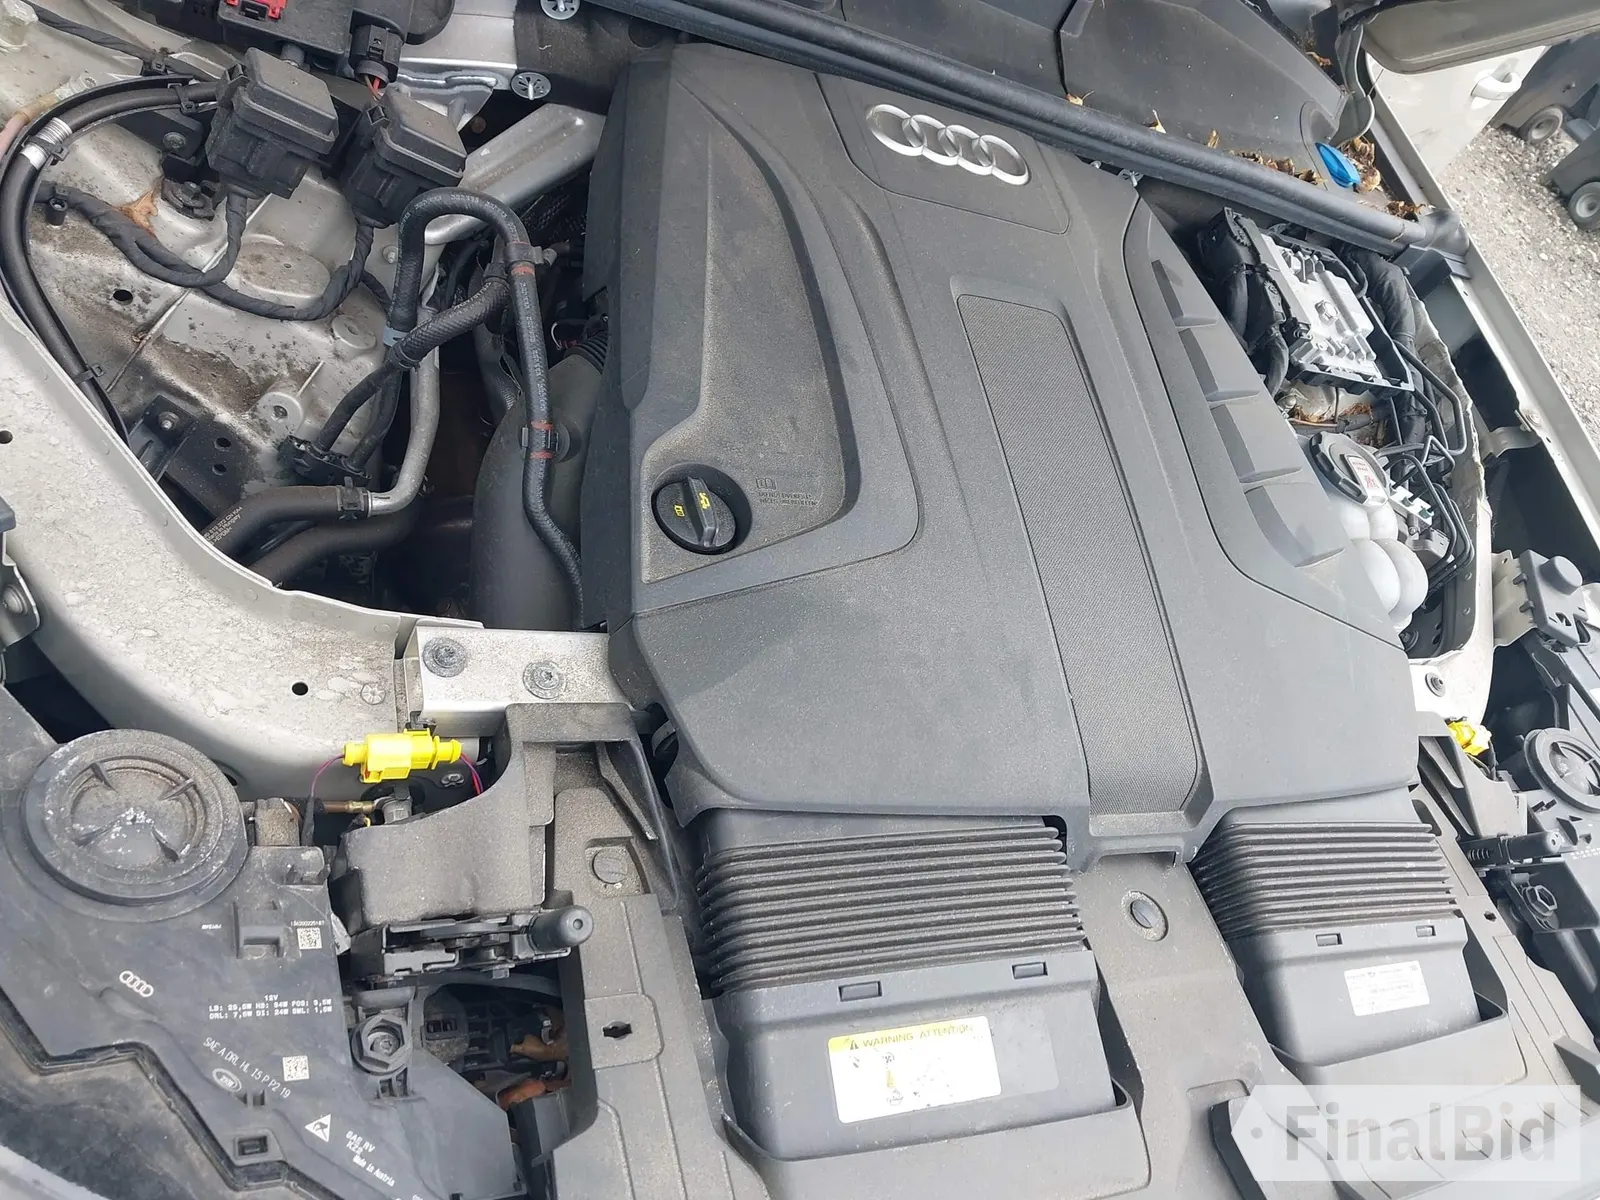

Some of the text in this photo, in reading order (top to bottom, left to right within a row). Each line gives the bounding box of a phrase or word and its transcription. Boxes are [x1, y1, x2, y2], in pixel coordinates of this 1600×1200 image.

[264, 994, 279, 1002] 12V
[862, 1024, 973, 1047] WARNING ATTENTION
[203, 1037, 220, 1052] SAE
[217, 1047, 226, 1057] A
[224, 1050, 240, 1066] DRL
[239, 1060, 250, 1073] HL
[261, 1074, 270, 1083] P
[267, 1079, 281, 1092] P2
[280, 1087, 291, 1099] 19
